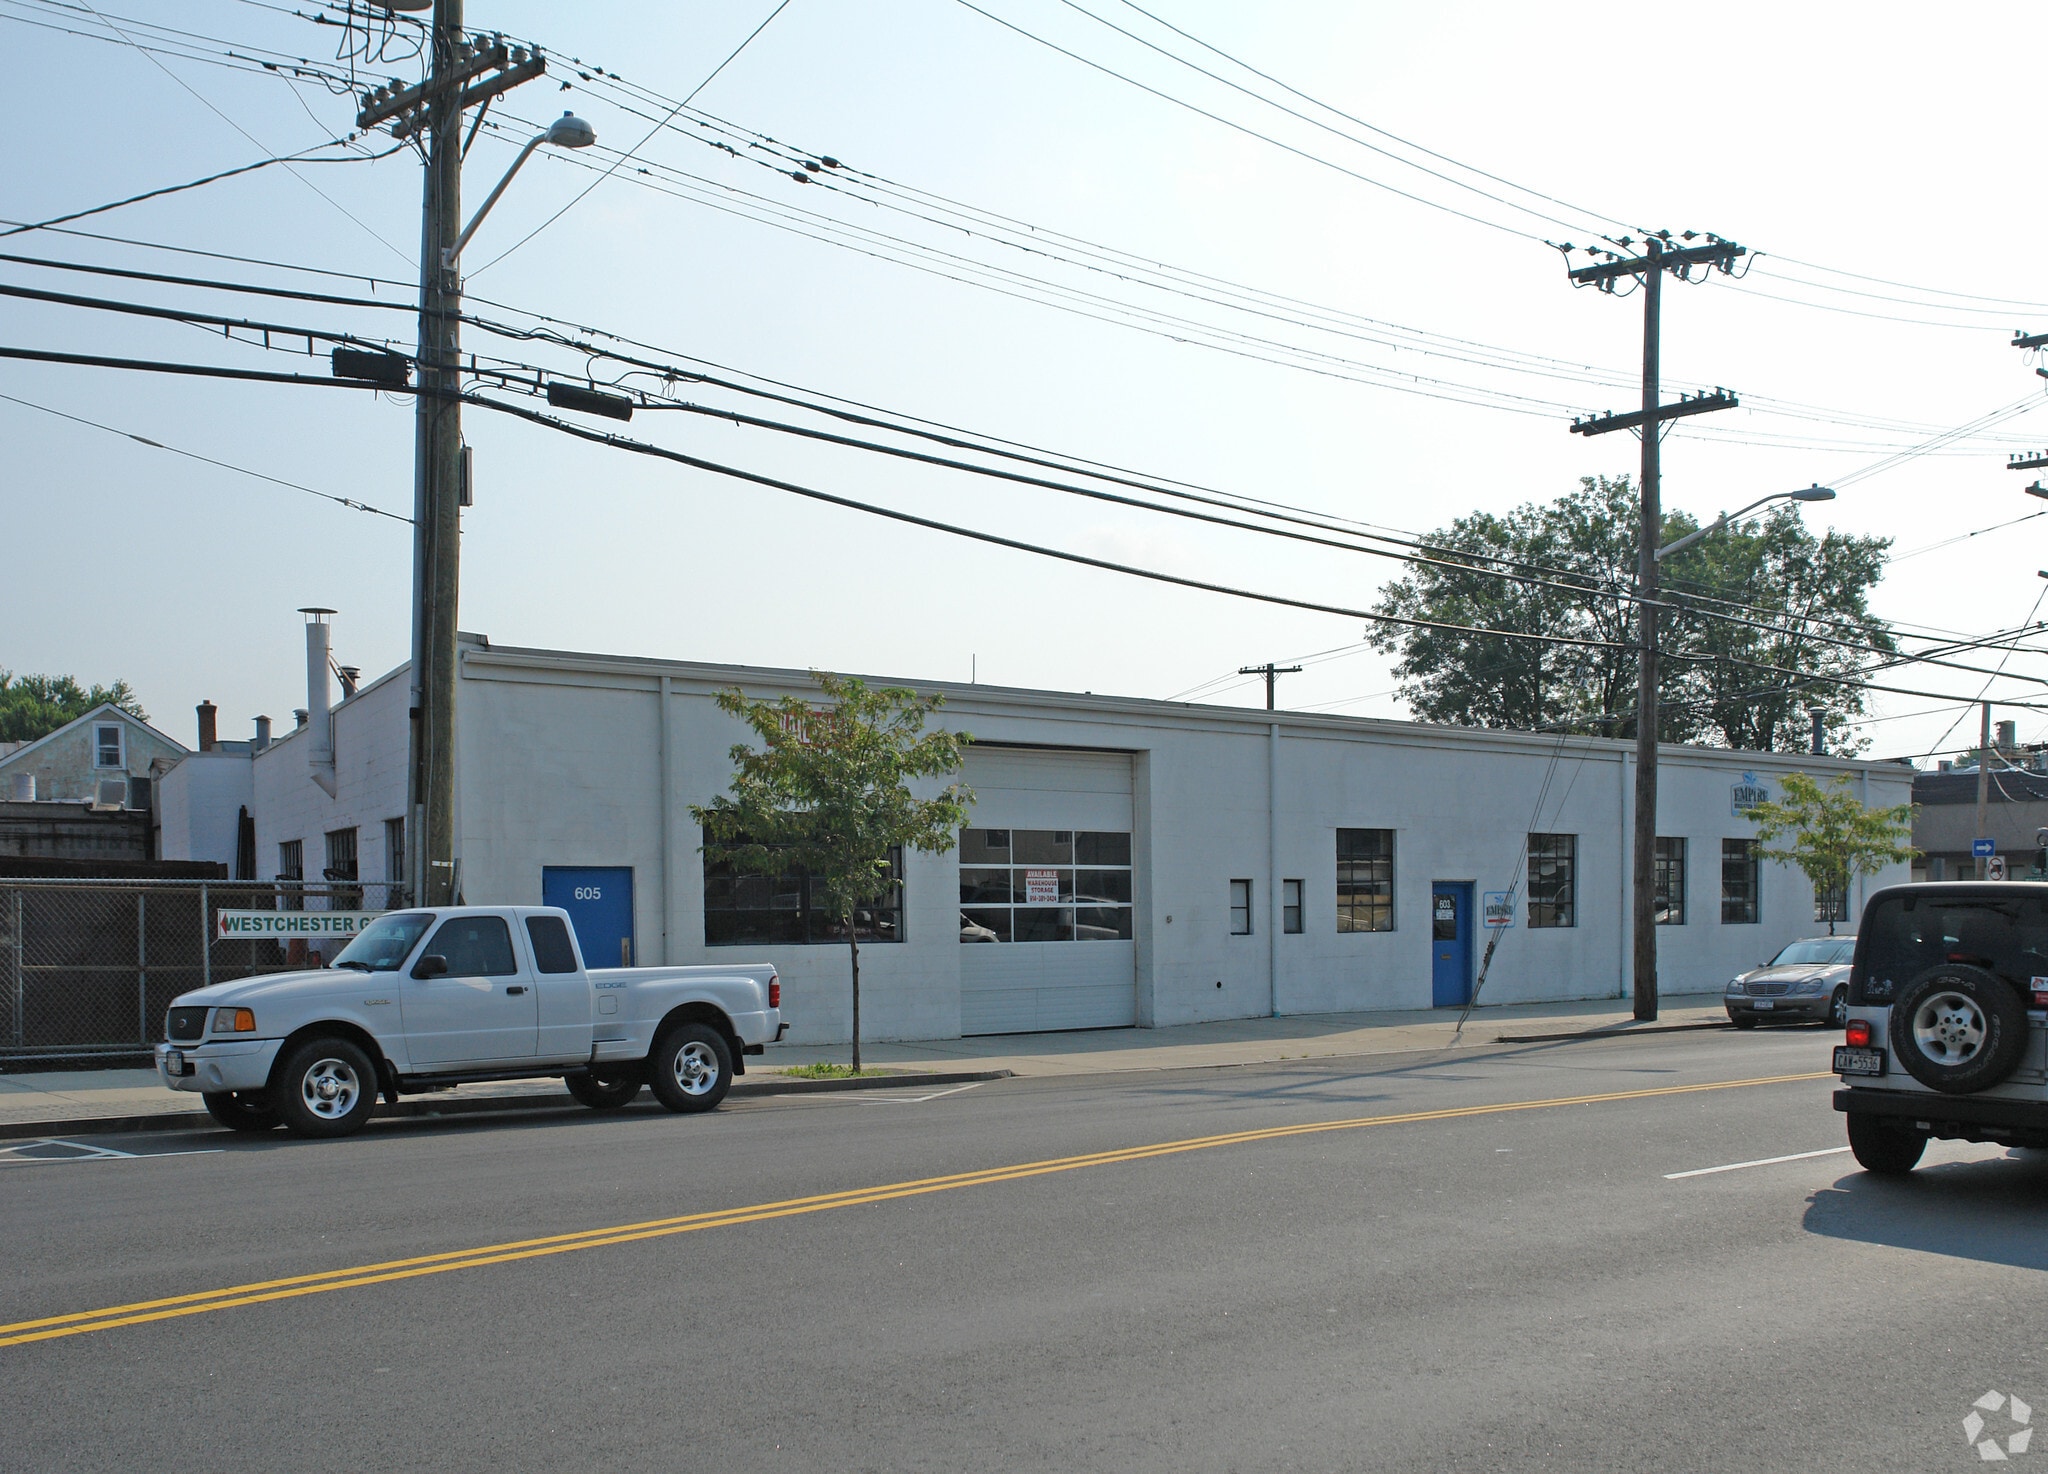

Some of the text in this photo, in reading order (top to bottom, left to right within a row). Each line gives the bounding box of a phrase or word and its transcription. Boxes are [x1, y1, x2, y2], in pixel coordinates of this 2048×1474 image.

[1734, 785, 1769, 802] EMPIRE
[1027, 870, 1057, 878] AVAILABLE
[574, 887, 602, 900] 605
[1439, 899, 1451, 909] 603
[226, 916, 354, 932] WESTCHESTER
[595, 982, 628, 990] EDGE
